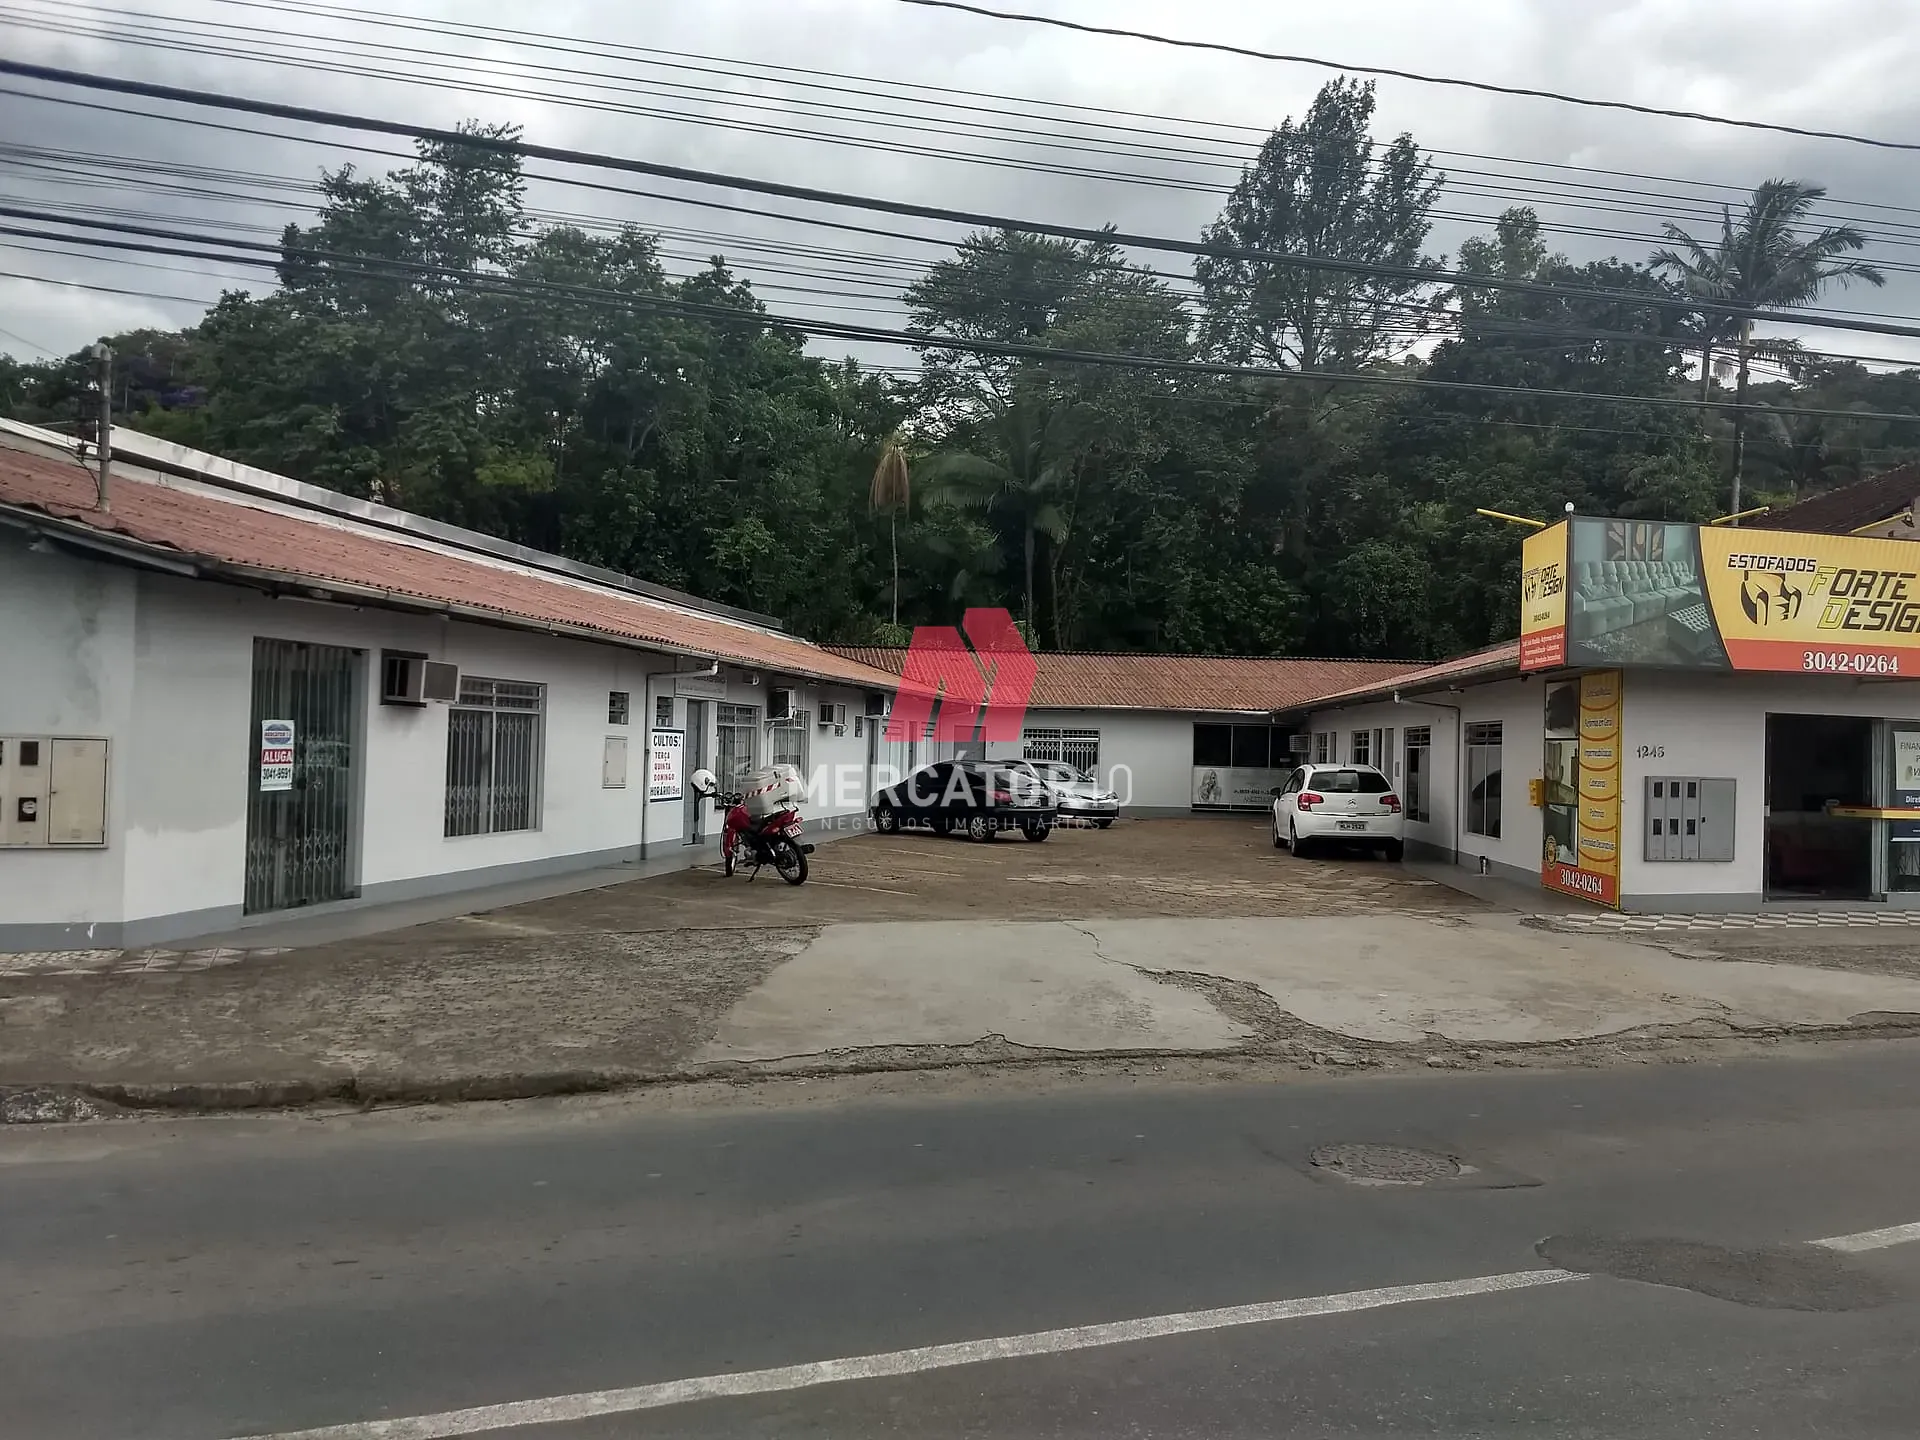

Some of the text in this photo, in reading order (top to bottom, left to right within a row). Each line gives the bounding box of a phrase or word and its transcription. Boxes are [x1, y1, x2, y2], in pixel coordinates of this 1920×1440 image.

[1728, 554, 1817, 573] ESTOFADOS
[1808, 566, 1917, 600] FORTE
[1817, 597, 1920, 633] DESIG
[1803, 651, 1899, 674] 3042-0264
[653, 735, 681, 747] CULTOS:
[263, 750, 293, 763] ALUGA
[655, 752, 670, 762] TERÇA
[653, 773, 675, 782] DOMINGO
[1559, 868, 1603, 895] 3042-0264
